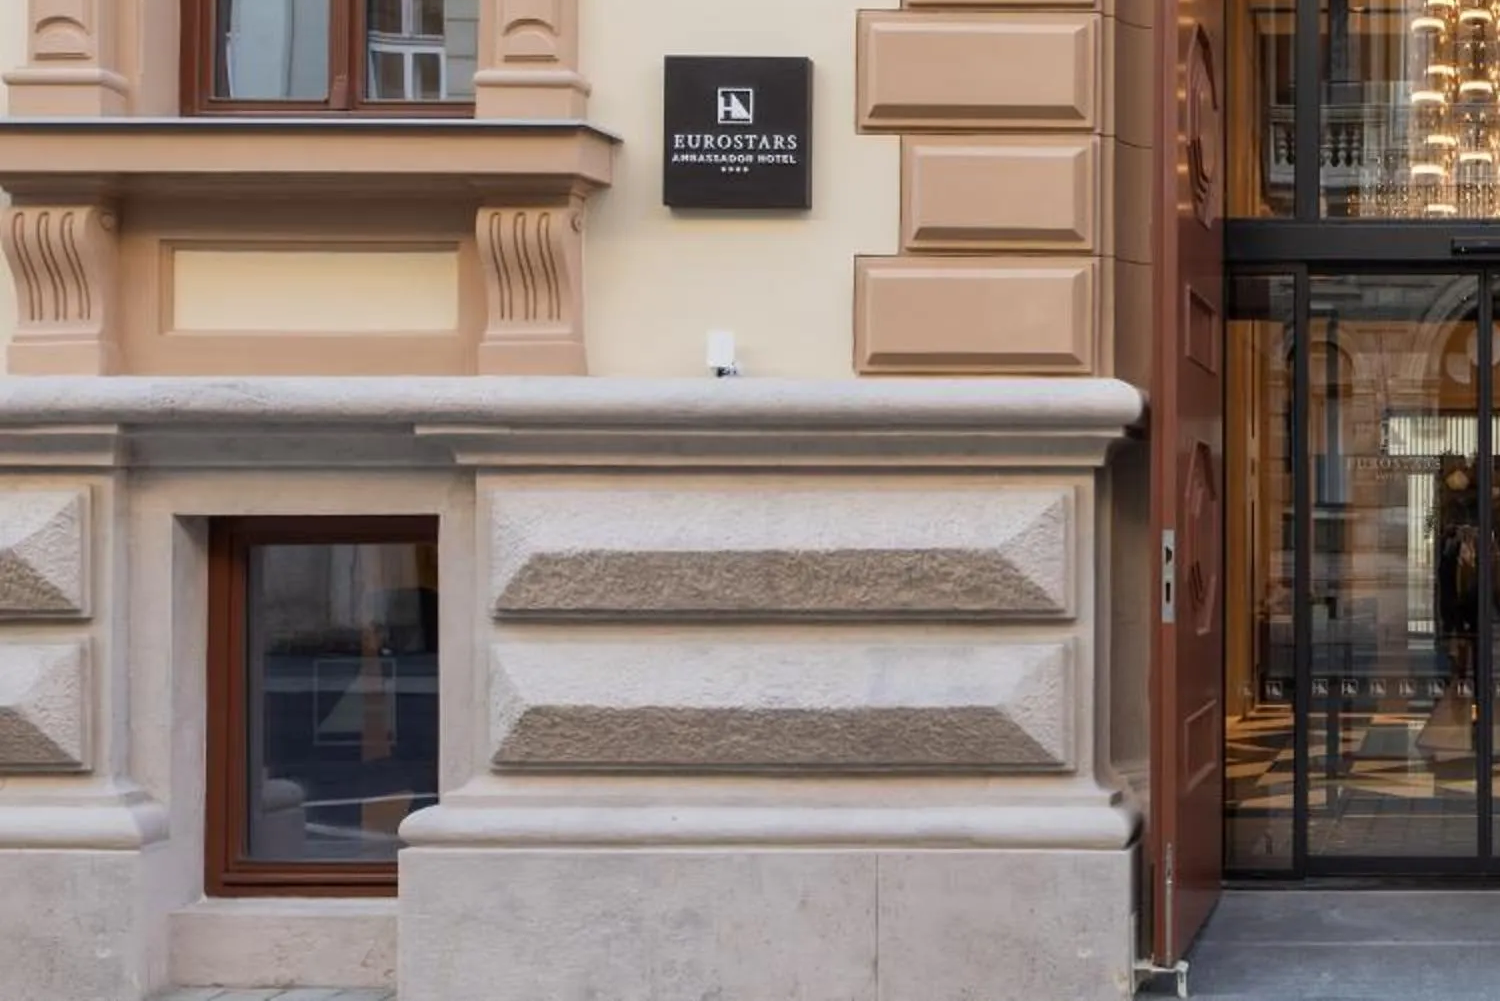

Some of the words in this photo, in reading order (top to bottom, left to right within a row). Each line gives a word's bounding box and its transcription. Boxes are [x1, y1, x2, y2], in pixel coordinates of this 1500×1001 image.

[674, 135, 797, 149] EUROSTARS
[672, 154, 753, 164] AMBASSADOR
[758, 154, 797, 164] HOTEL
